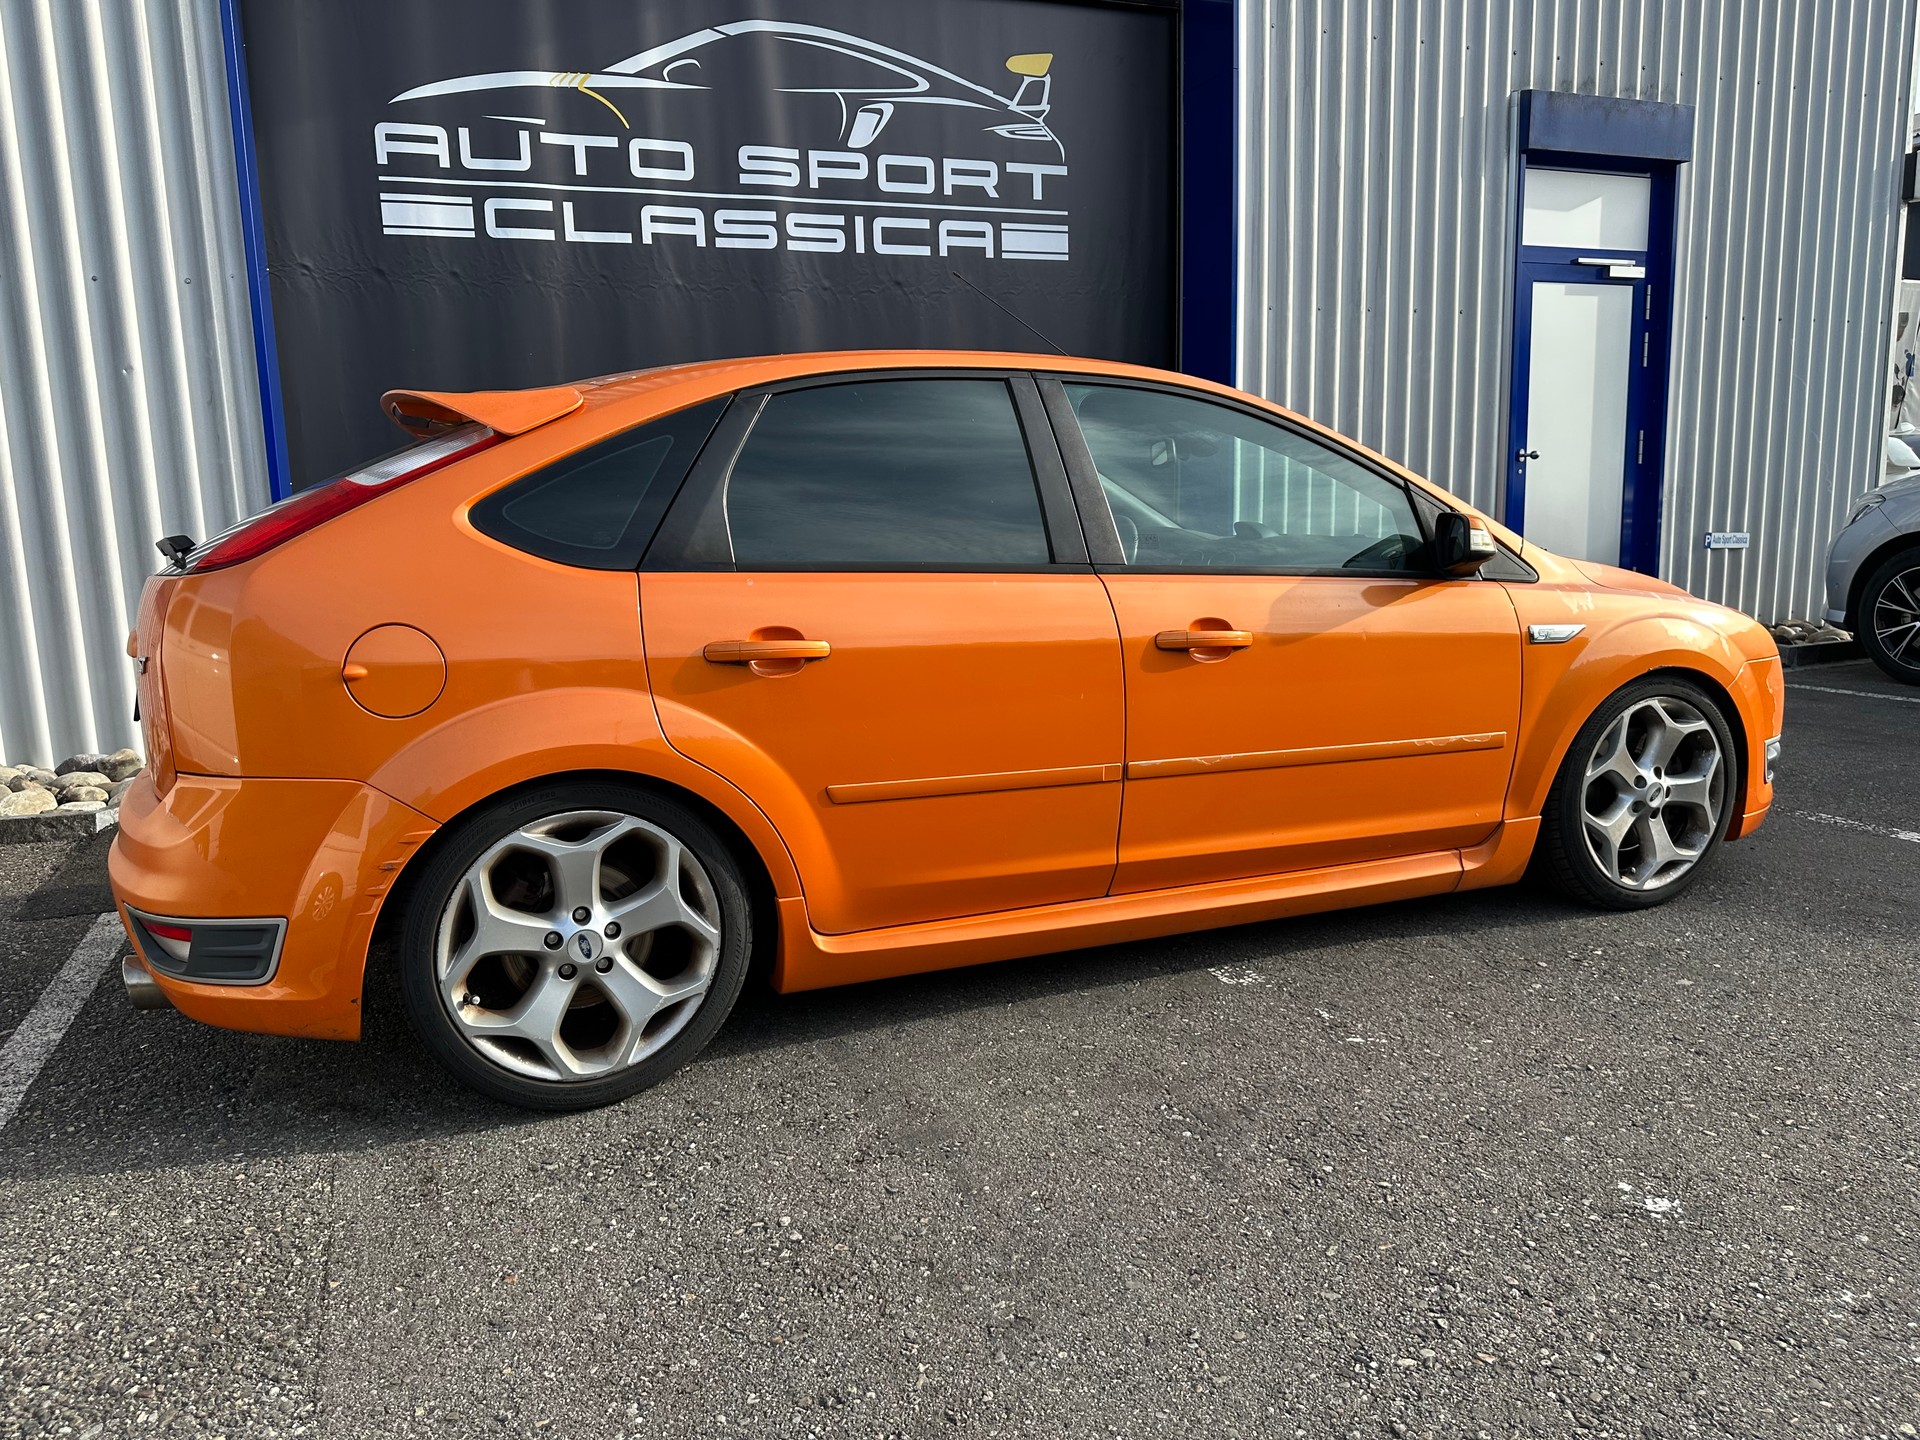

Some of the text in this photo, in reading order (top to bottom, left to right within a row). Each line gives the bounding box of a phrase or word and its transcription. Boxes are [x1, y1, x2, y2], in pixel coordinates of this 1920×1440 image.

[374, 121, 1068, 201] AUTO SPORT
[483, 197, 1001, 259] CLASSICA
[1705, 534, 1748, 547] P Auto Sport Classica
